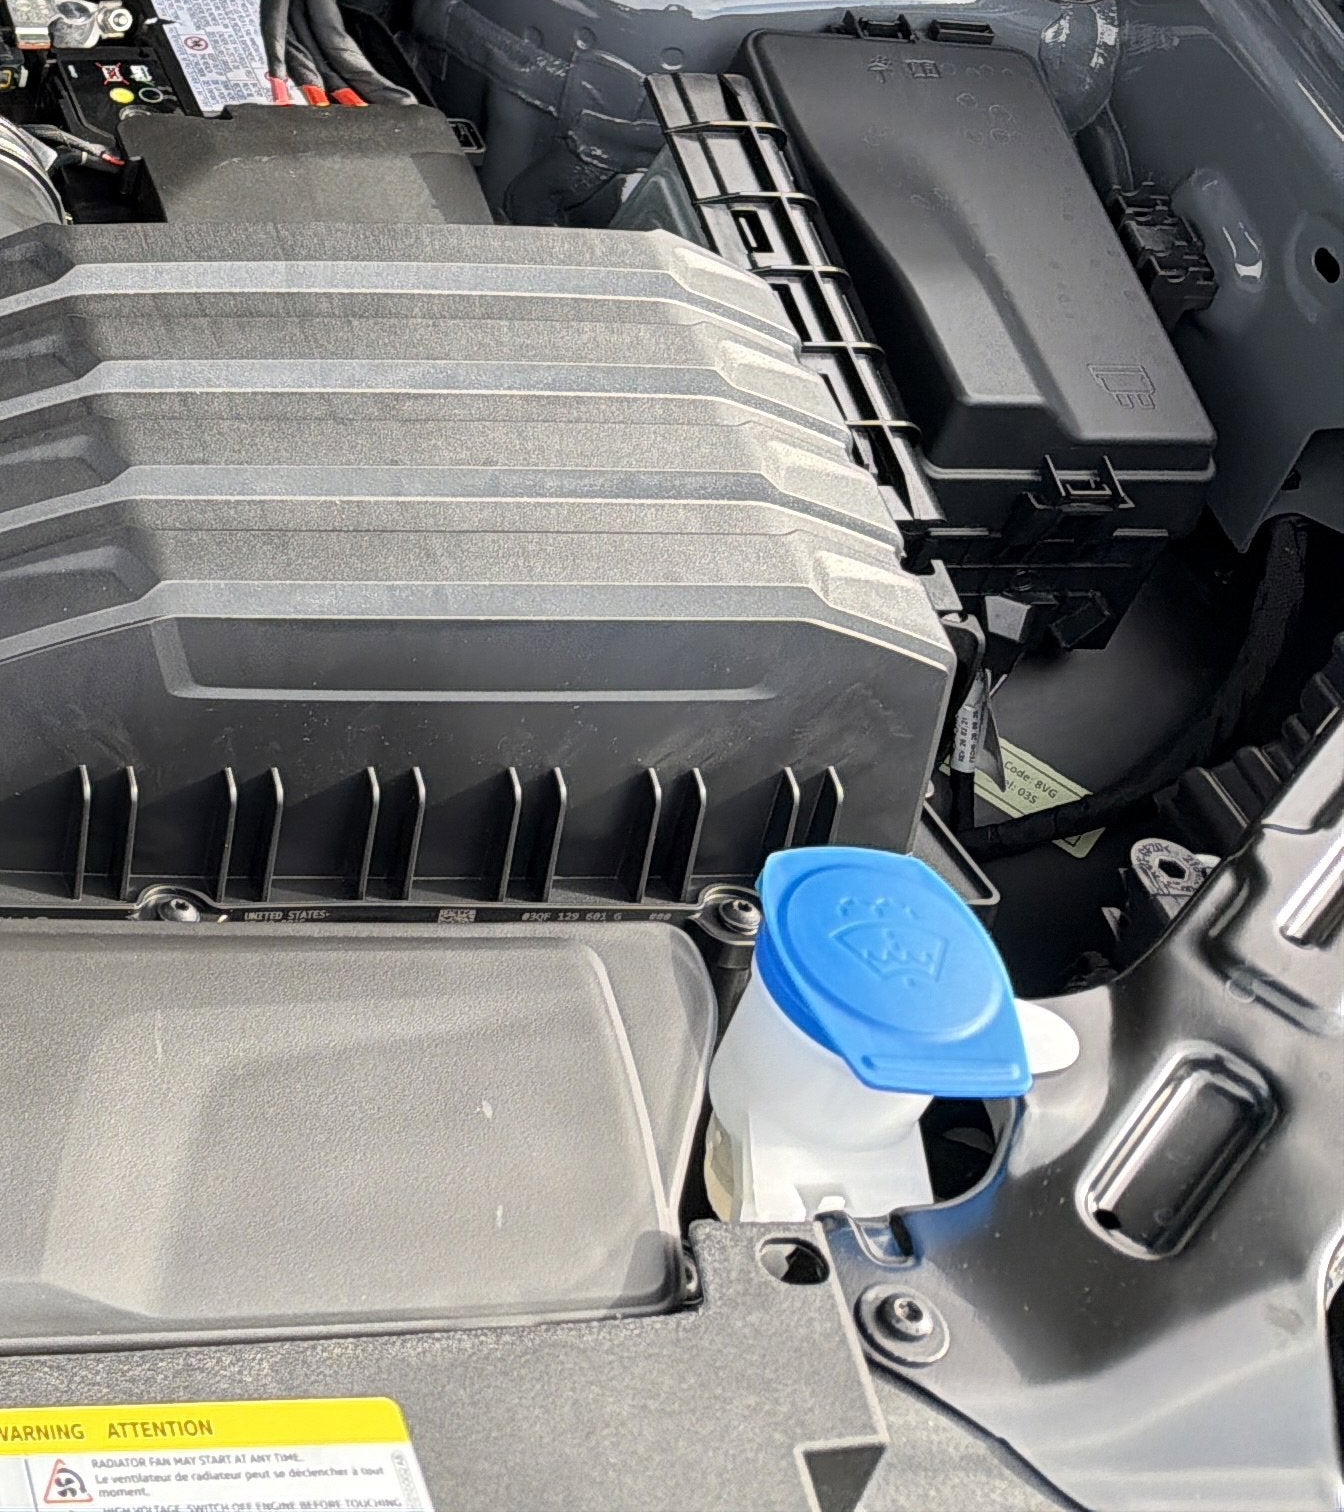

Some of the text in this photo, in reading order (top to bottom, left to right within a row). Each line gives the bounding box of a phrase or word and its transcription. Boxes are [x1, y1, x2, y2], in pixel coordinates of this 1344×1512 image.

[1004, 760, 1058, 799] Code: 8VG
[1017, 787, 1038, 805] 03S
[244, 910, 282, 920] UNITED
[108, 1419, 213, 1439] ATTENTION
[91, 1458, 146, 1469] RADIATOR
[149, 1457, 171, 1467] FAN
[173, 1456, 196, 1466] MAY
[199, 1455, 232, 1465] START
[234, 1454, 247, 1464] AT
[250, 1454, 272, 1464] ANY
[95, 1474, 109, 1484] Le
[111, 1472, 172, 1483] ventilateur
[174, 1472, 189, 1482] de
[191, 1469, 242, 1481] radiateur
[245, 1469, 271, 1482] peut
[361, 1467, 384, 1476] tout
[344, 1498, 402, 1509] TOUCHING
